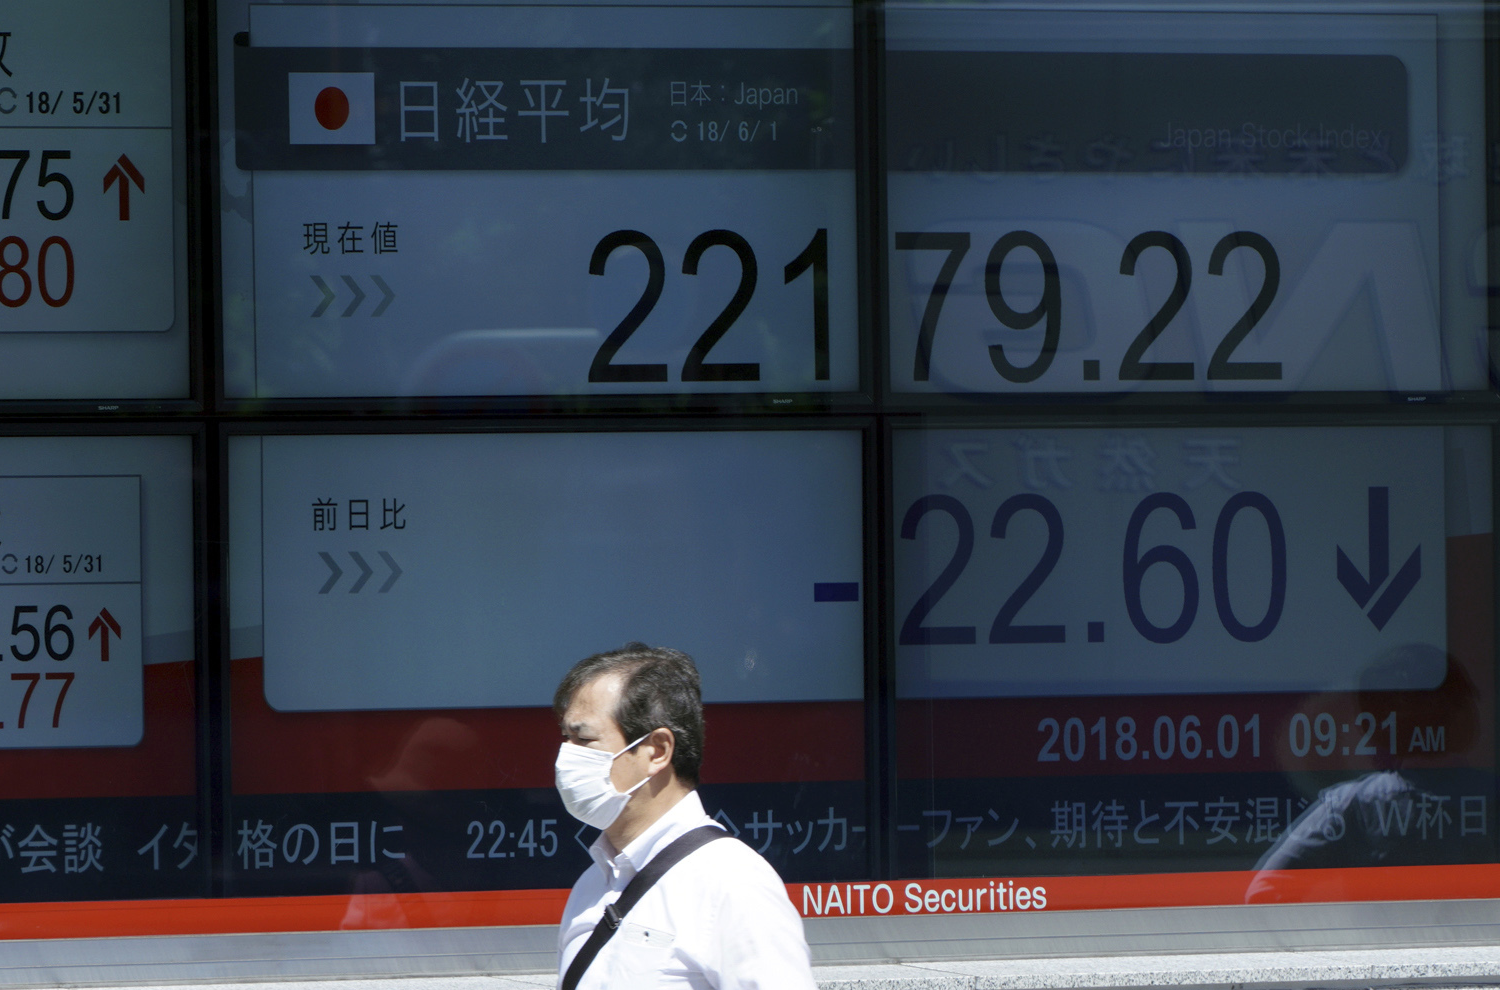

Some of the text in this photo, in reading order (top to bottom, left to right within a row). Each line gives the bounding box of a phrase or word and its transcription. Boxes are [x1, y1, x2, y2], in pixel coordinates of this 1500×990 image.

[398, 77, 631, 143] 日経平均
[1160, 121, 1384, 150] Japan Stock Index
[302, 220, 399, 256] 現在値
[311, 496, 407, 532] 前日比
[1036, 710, 1446, 763] 2018.06.01 09:21 AM
[237, 817, 407, 871] 格の日に
[466, 818, 559, 860] 22:45
[802, 880, 1048, 916] NAITO Securities
